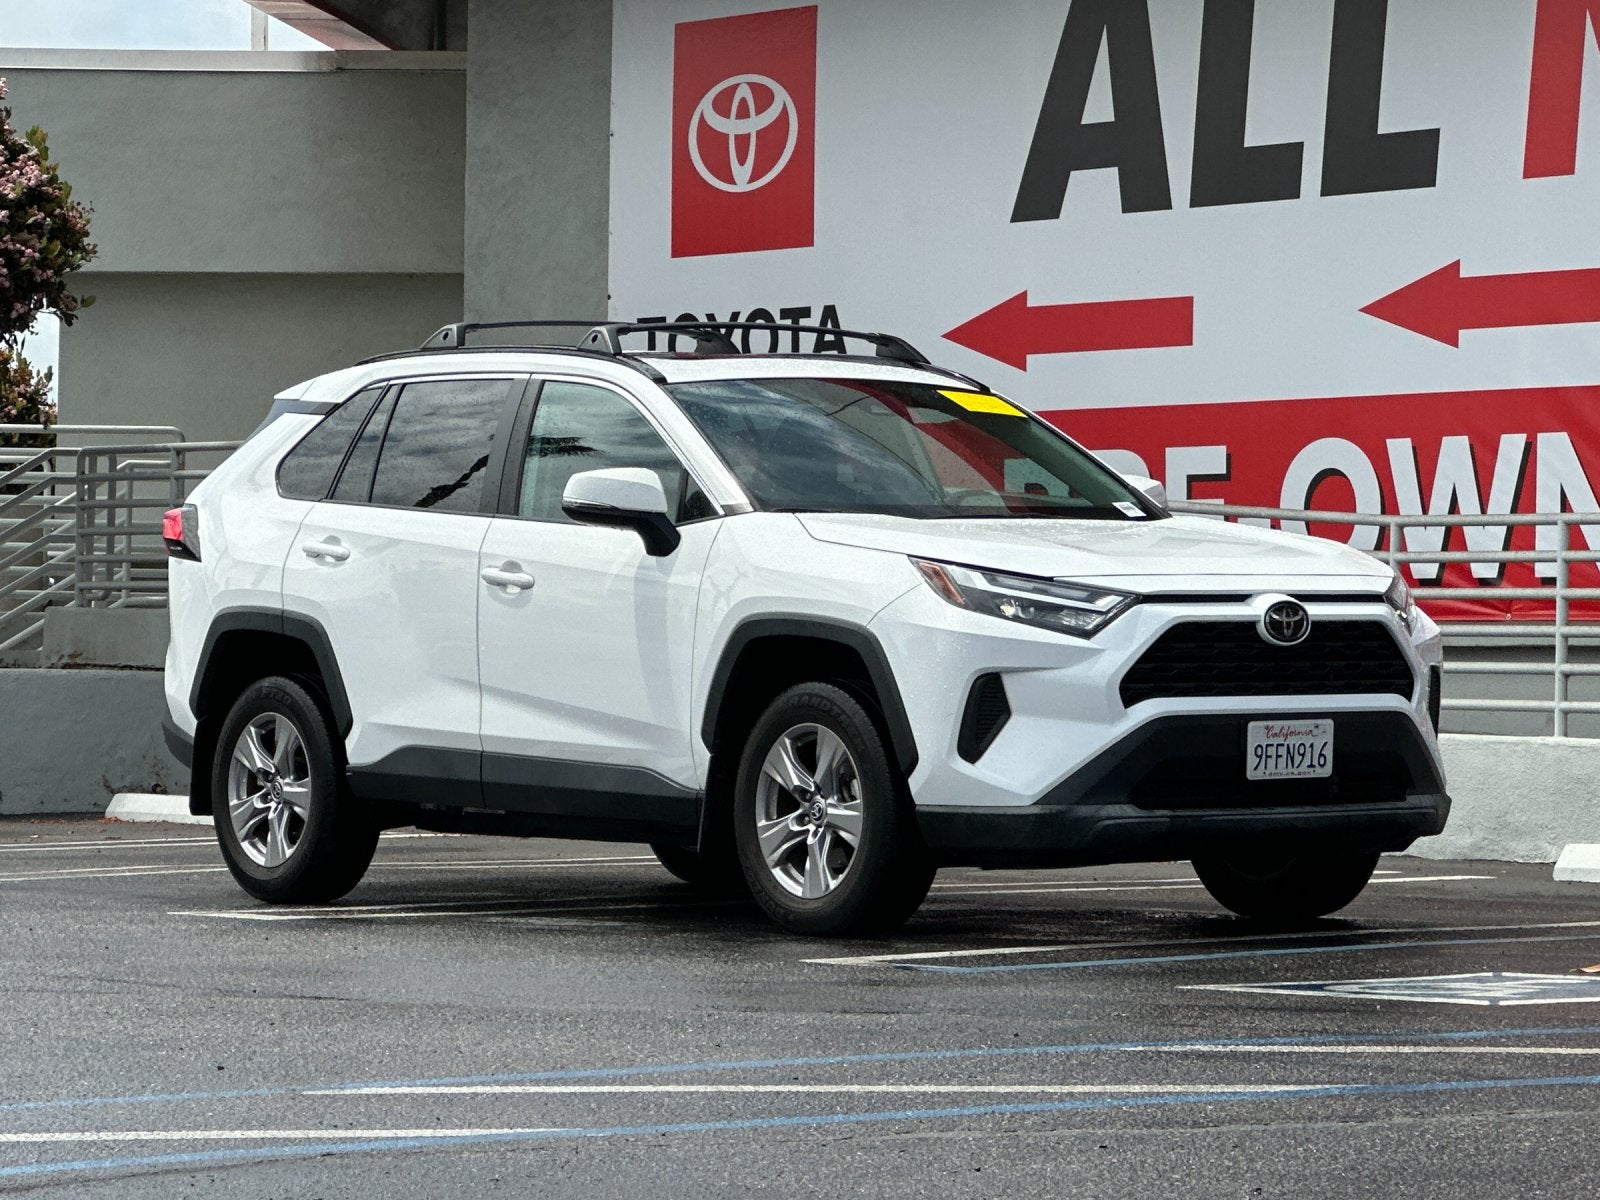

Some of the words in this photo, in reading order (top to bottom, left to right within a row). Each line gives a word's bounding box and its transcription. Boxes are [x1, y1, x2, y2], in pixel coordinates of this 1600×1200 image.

[1010, 0, 1440, 223] ALL
[1266, 725, 1318, 742] California
[1253, 741, 1328, 771] 9FFN916
